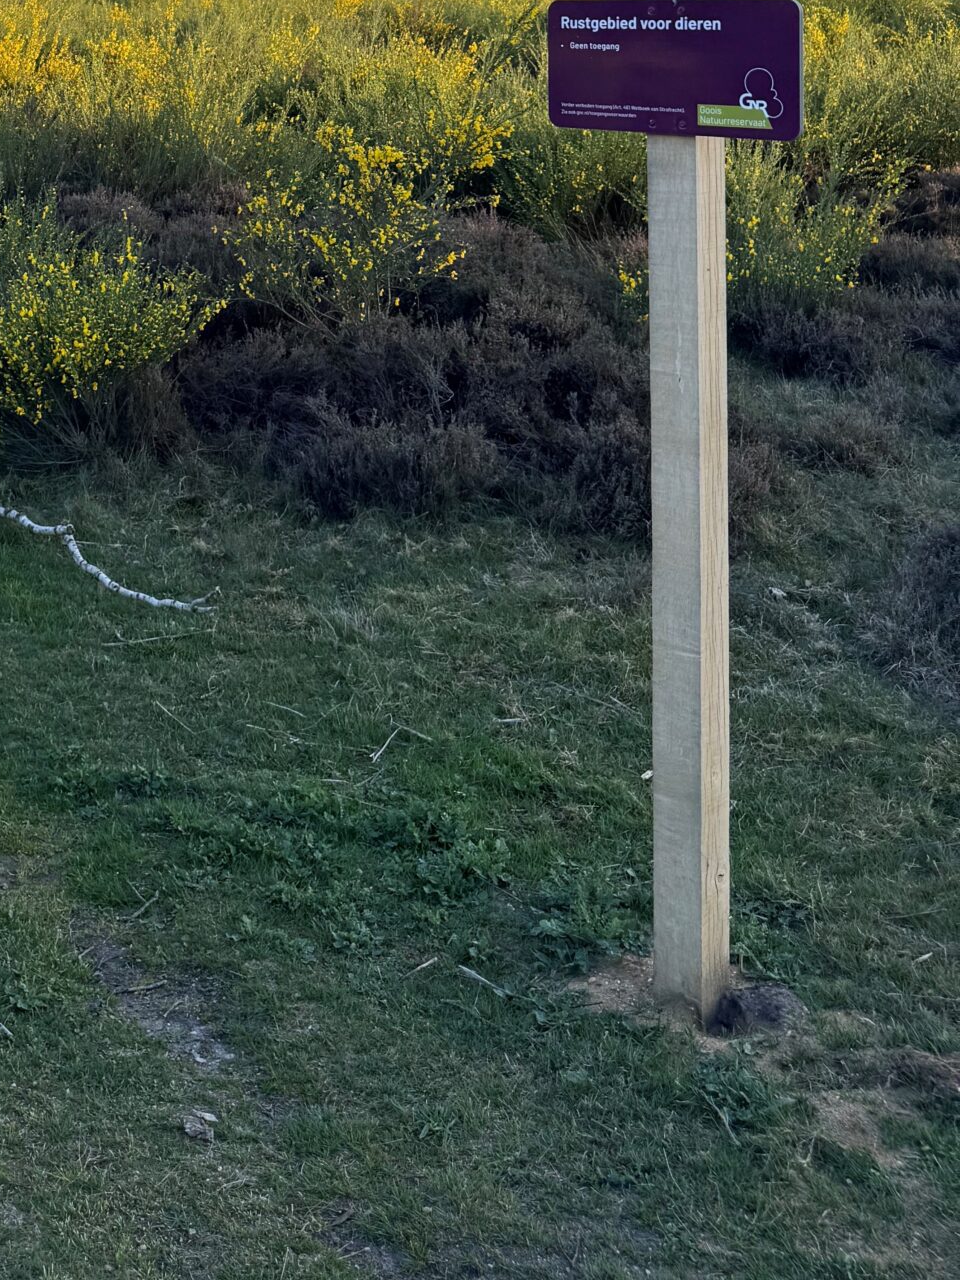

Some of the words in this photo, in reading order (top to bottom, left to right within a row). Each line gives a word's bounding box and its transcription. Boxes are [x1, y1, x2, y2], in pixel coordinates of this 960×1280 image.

[560, 16, 637, 33] Rustgebied
[640, 19, 672, 31] voor
[675, 16, 722, 31] dieren
[569, 42, 588, 50] Geen
[589, 42, 620, 52] toegang
[699, 105, 722, 115] Goois
[699, 115, 766, 128] Natuurreservaat
